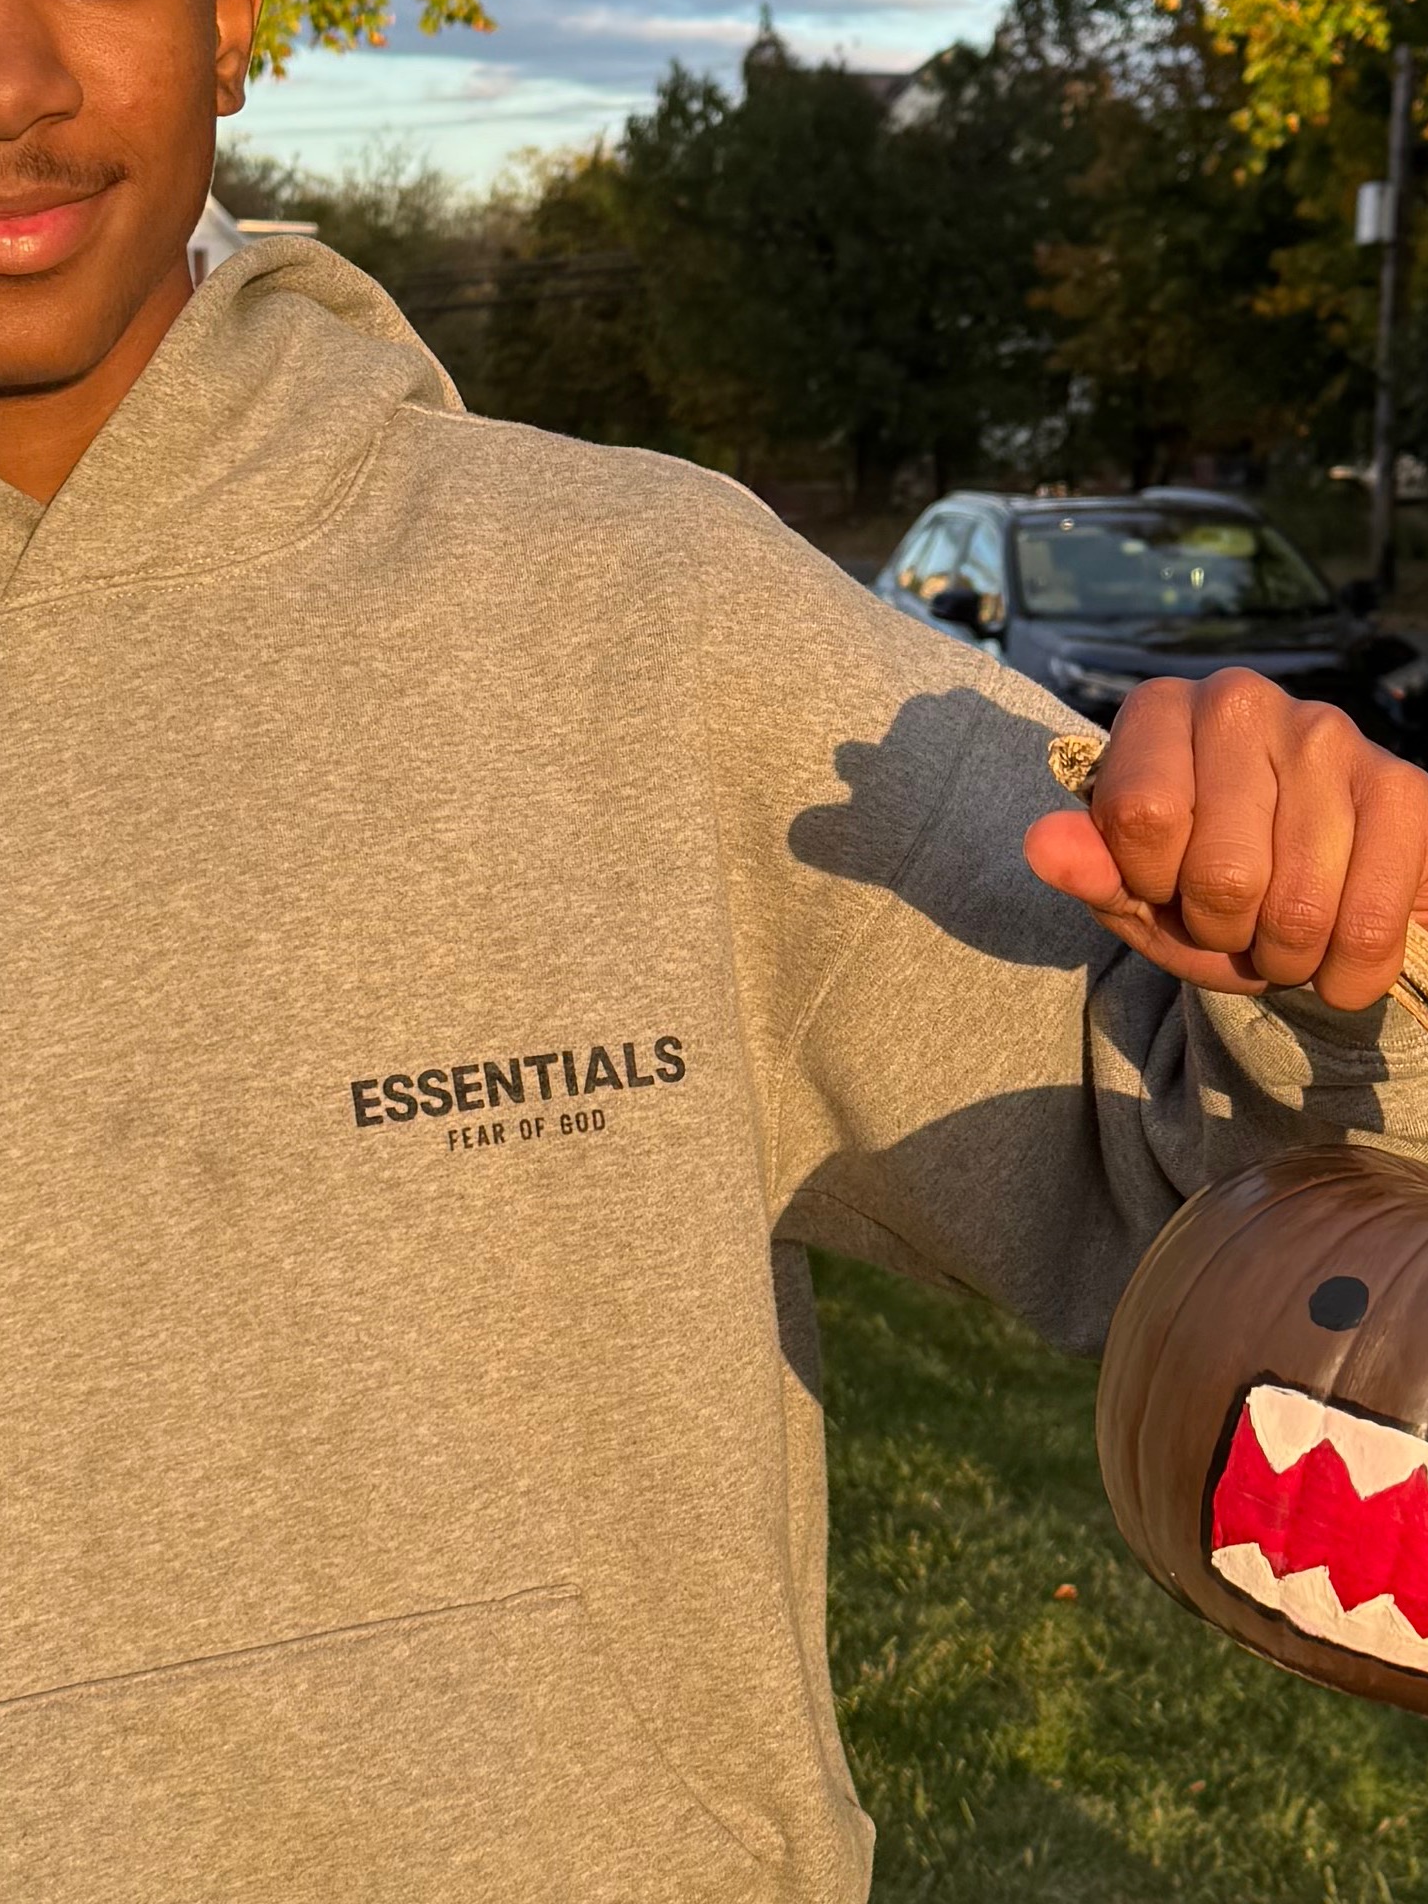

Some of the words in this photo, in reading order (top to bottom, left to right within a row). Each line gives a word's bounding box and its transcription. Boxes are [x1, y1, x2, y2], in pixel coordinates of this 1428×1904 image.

[349, 1034, 687, 1129] ESSENTIALS
[447, 1121, 507, 1153] FEAR
[519, 1116, 546, 1141] OF
[559, 1108, 607, 1136] GOD
